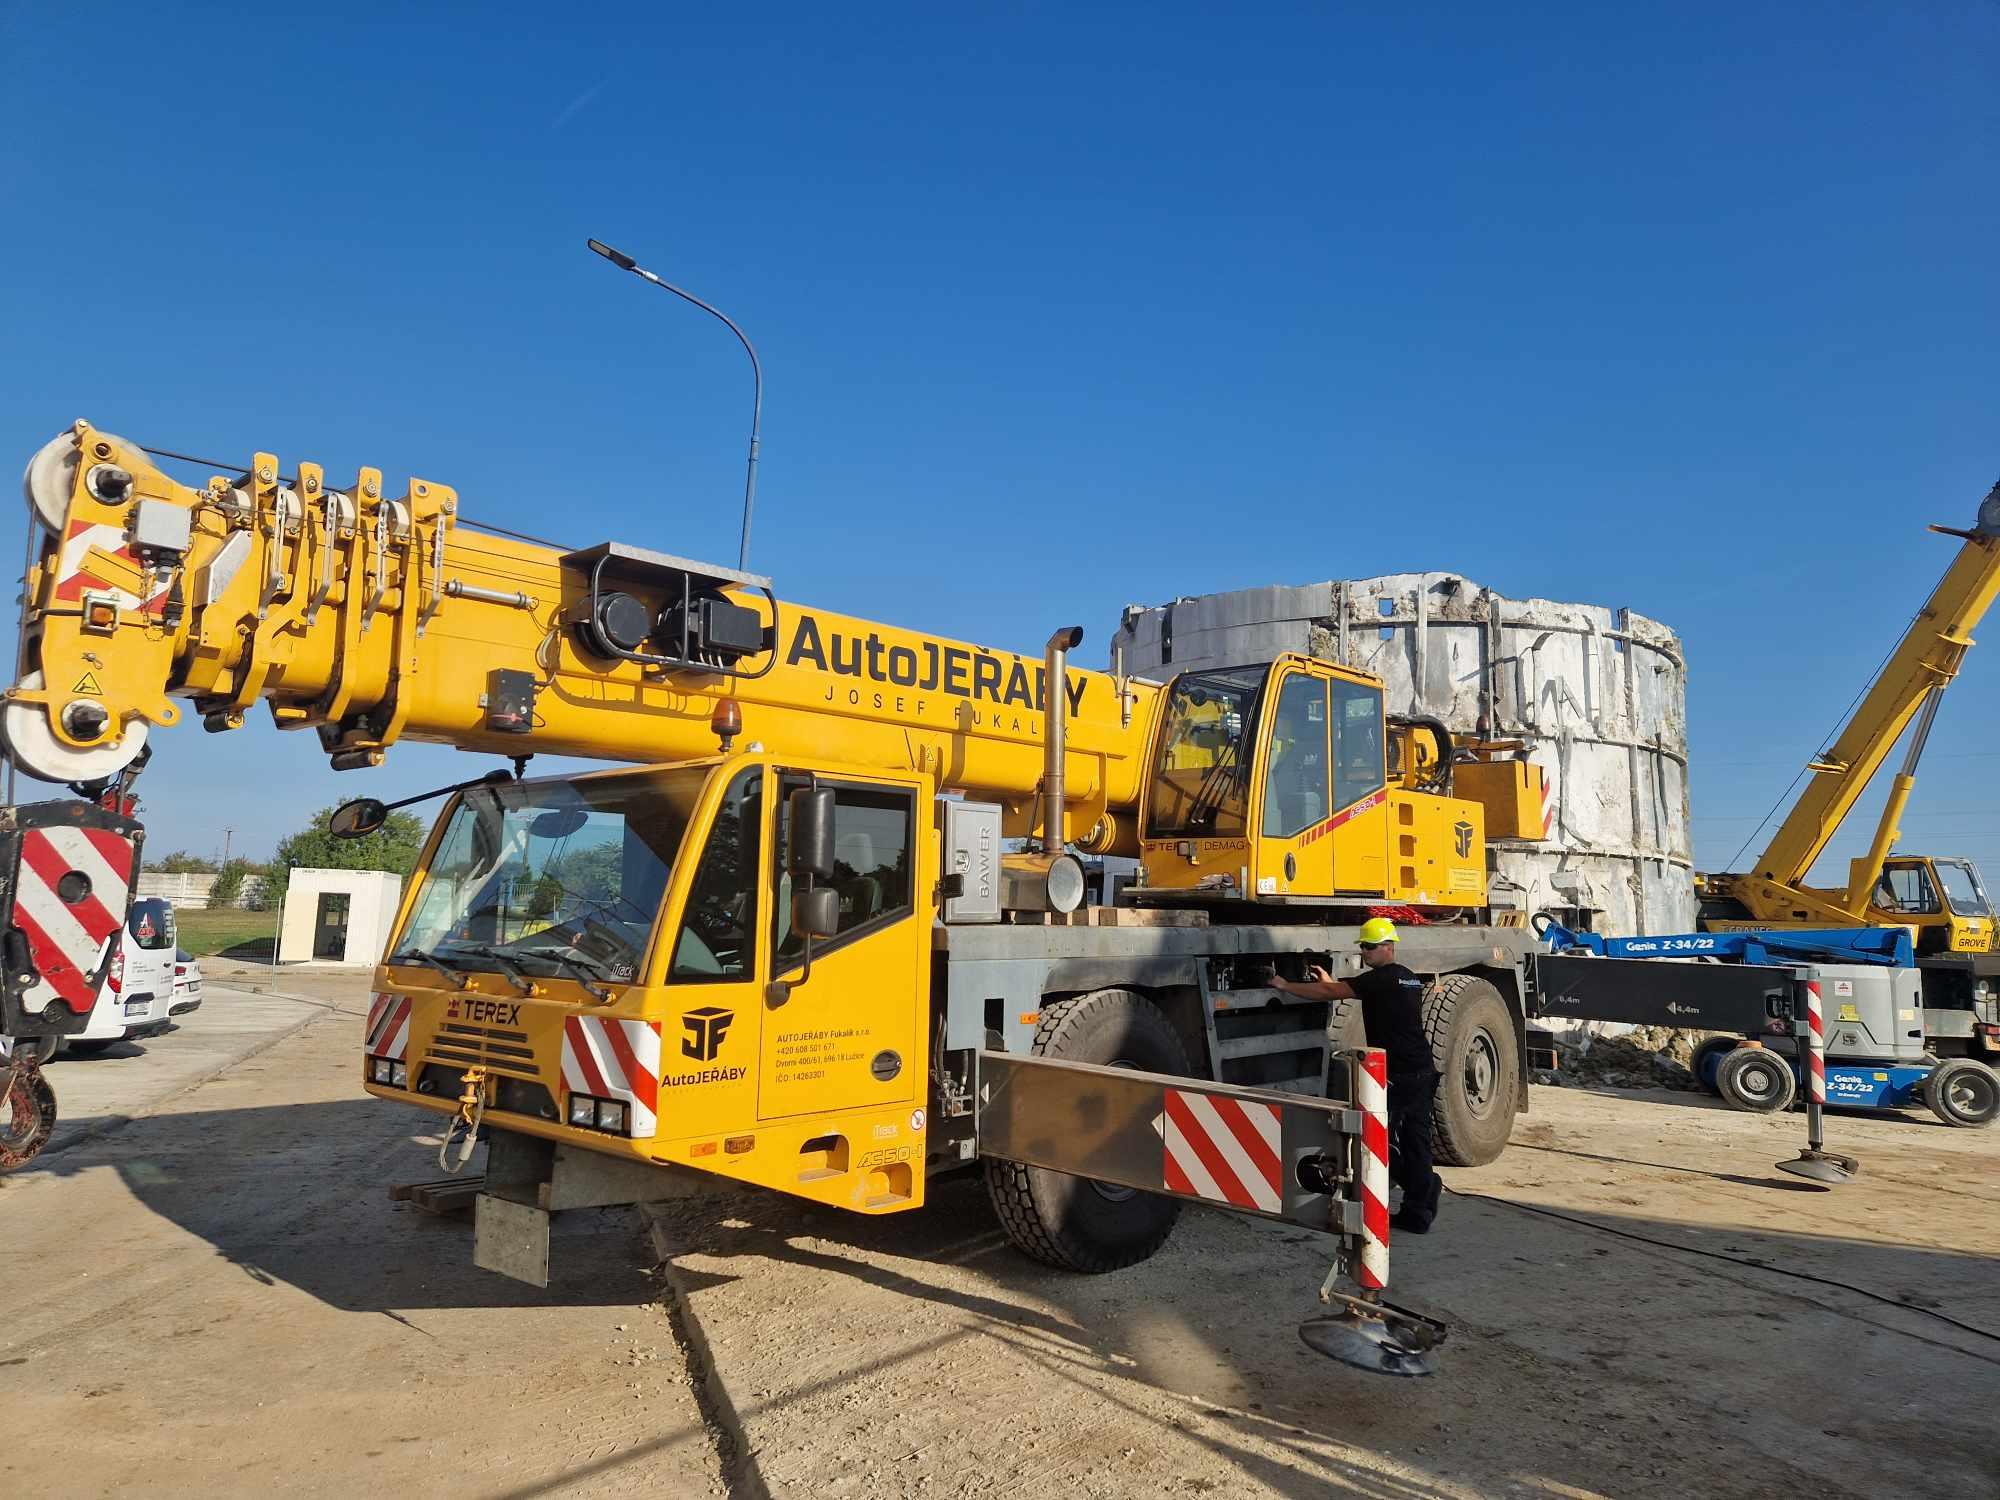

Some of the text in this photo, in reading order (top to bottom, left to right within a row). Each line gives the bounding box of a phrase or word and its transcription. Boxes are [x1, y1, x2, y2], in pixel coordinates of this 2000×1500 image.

[825, 685, 1069, 740] JOSEF FUKALK
[1204, 841, 1245, 851] DEMAG
[980, 827, 992, 898] BAWER
[1626, 938, 1714, 952] Genie Z-34/22
[1959, 938, 1986, 948] GROVE
[464, 999, 521, 1026] TEREX
[661, 1065, 747, 1087] AutoJEŘÁBY
[1833, 1074, 1862, 1083] Genie
[1826, 1082, 1874, 1092] Z-34/22
